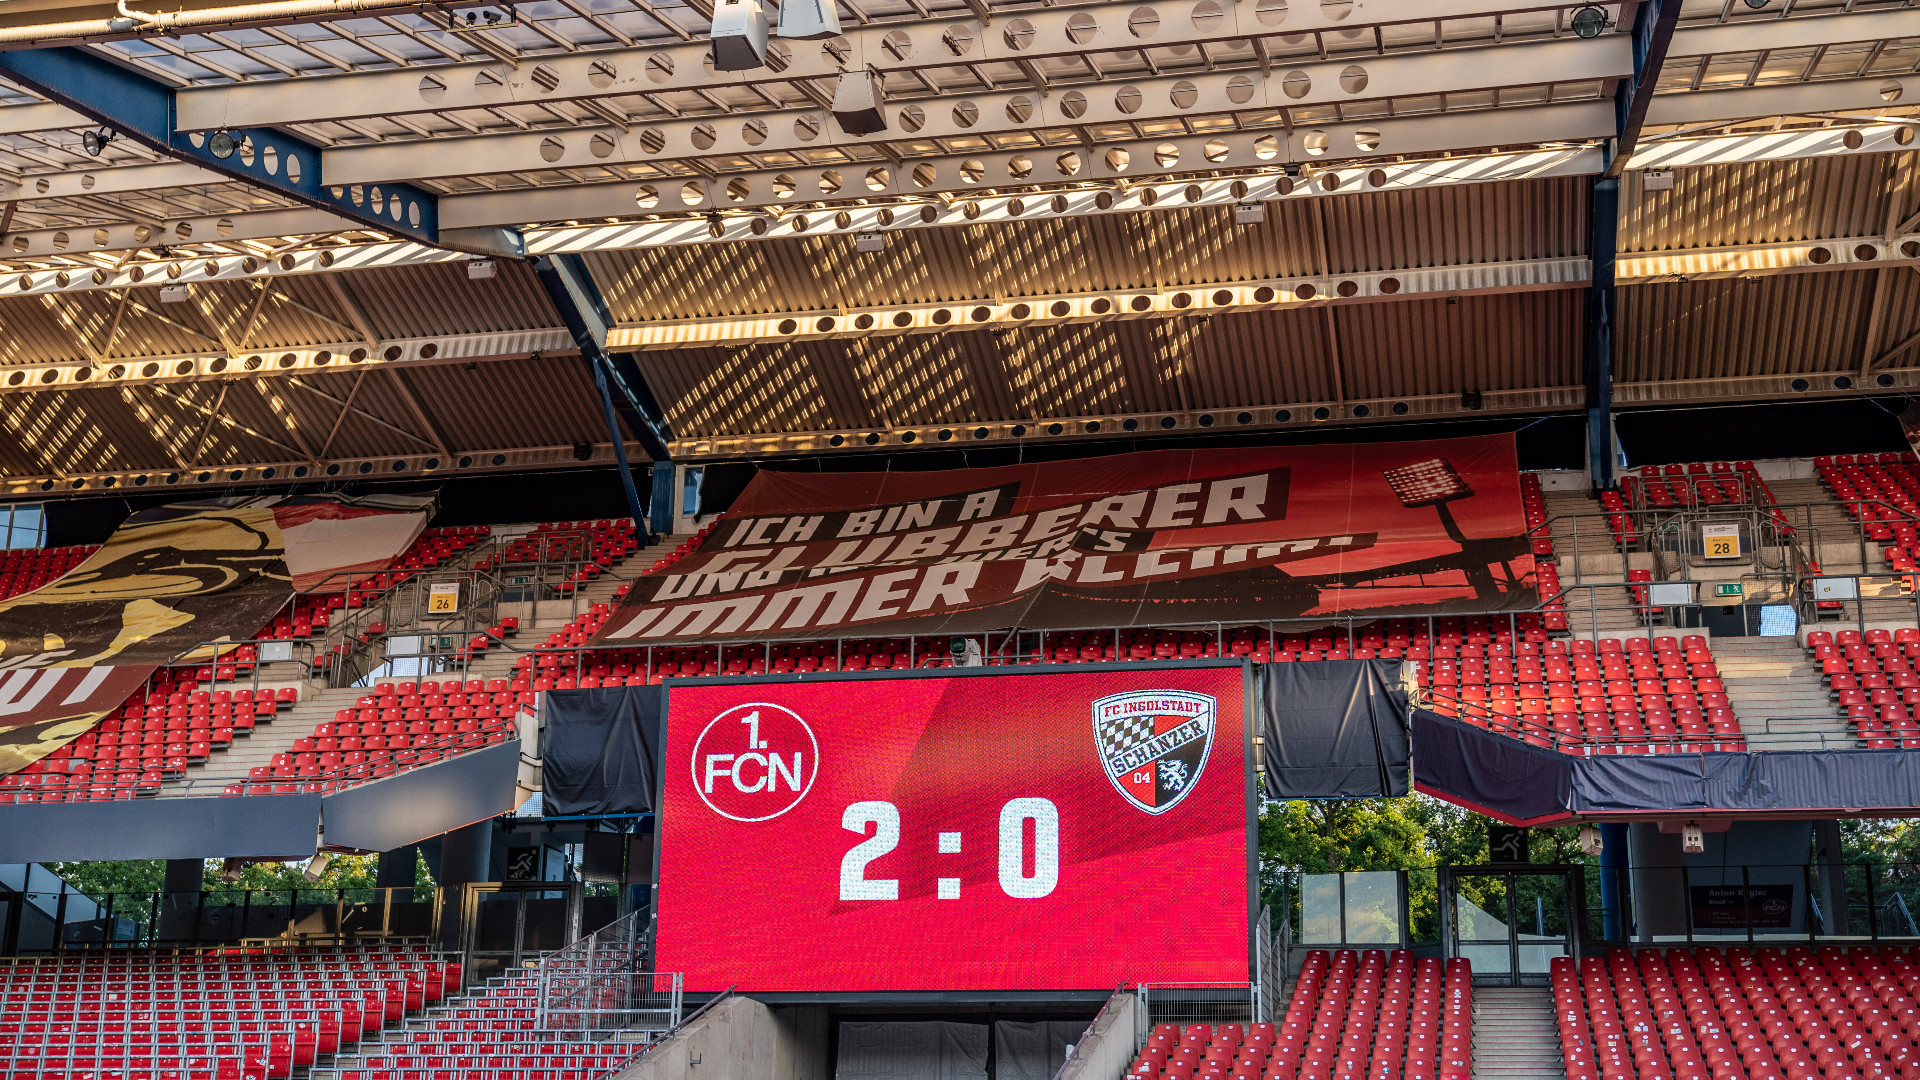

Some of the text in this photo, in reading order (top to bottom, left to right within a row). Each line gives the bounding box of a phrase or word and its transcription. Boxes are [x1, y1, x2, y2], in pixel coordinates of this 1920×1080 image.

[723, 489, 1001, 548] ICH BIN A
[1714, 543, 1730, 554] 28
[436, 599, 449, 609] 26
[605, 560, 983, 640] IMMER
[1104, 700, 1202, 717] FC INGOLSTADT
[1111, 720, 1206, 774] SCHANZER
[704, 751, 802, 794] FCN
[1133, 771, 1151, 784] 04
[1708, 889, 1767, 898] Anton Kgler
